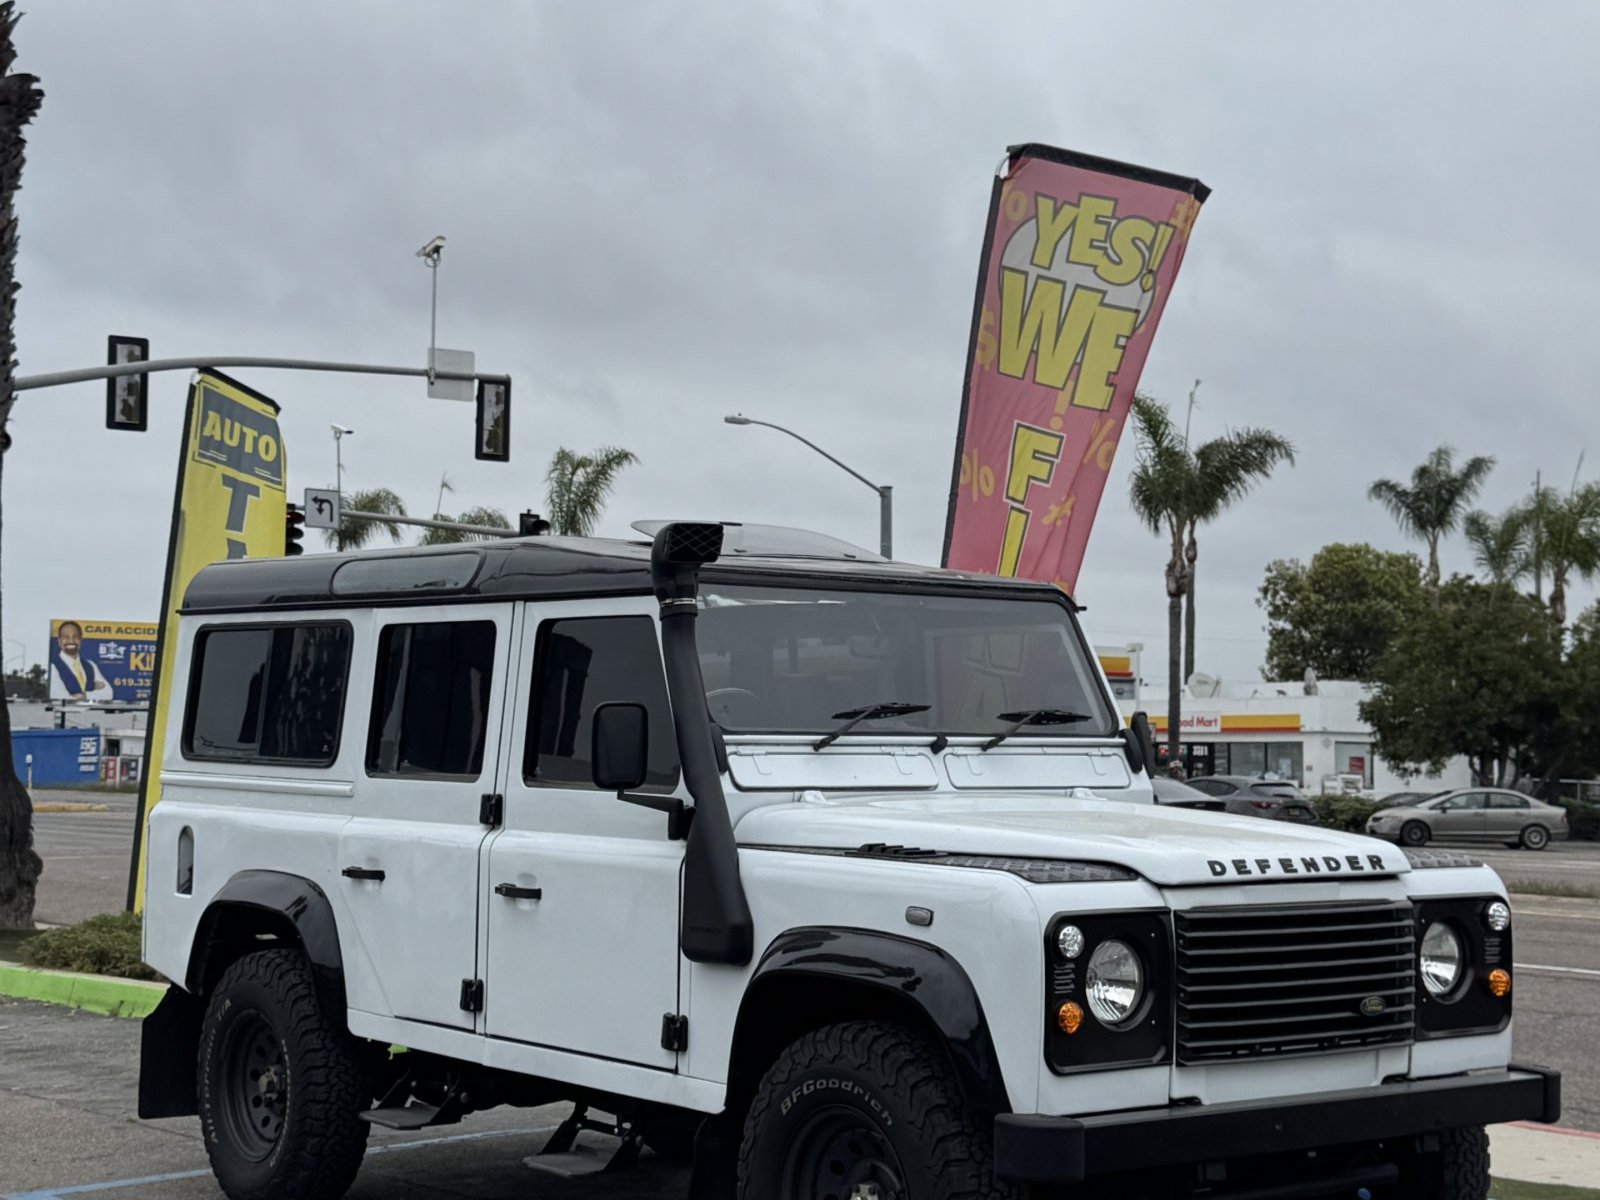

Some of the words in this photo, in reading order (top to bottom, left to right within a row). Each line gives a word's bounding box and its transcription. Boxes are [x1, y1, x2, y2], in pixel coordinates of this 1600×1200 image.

[1032, 192, 1177, 293] YES!
[997, 266, 1140, 411] WE
[203, 410, 277, 462] AUTO
[85, 625, 112, 634] CAR
[1196, 716, 1218, 727] Mart
[1207, 855, 1385, 877] DEFENDER
[781, 1079, 893, 1126] BFGoodrich
